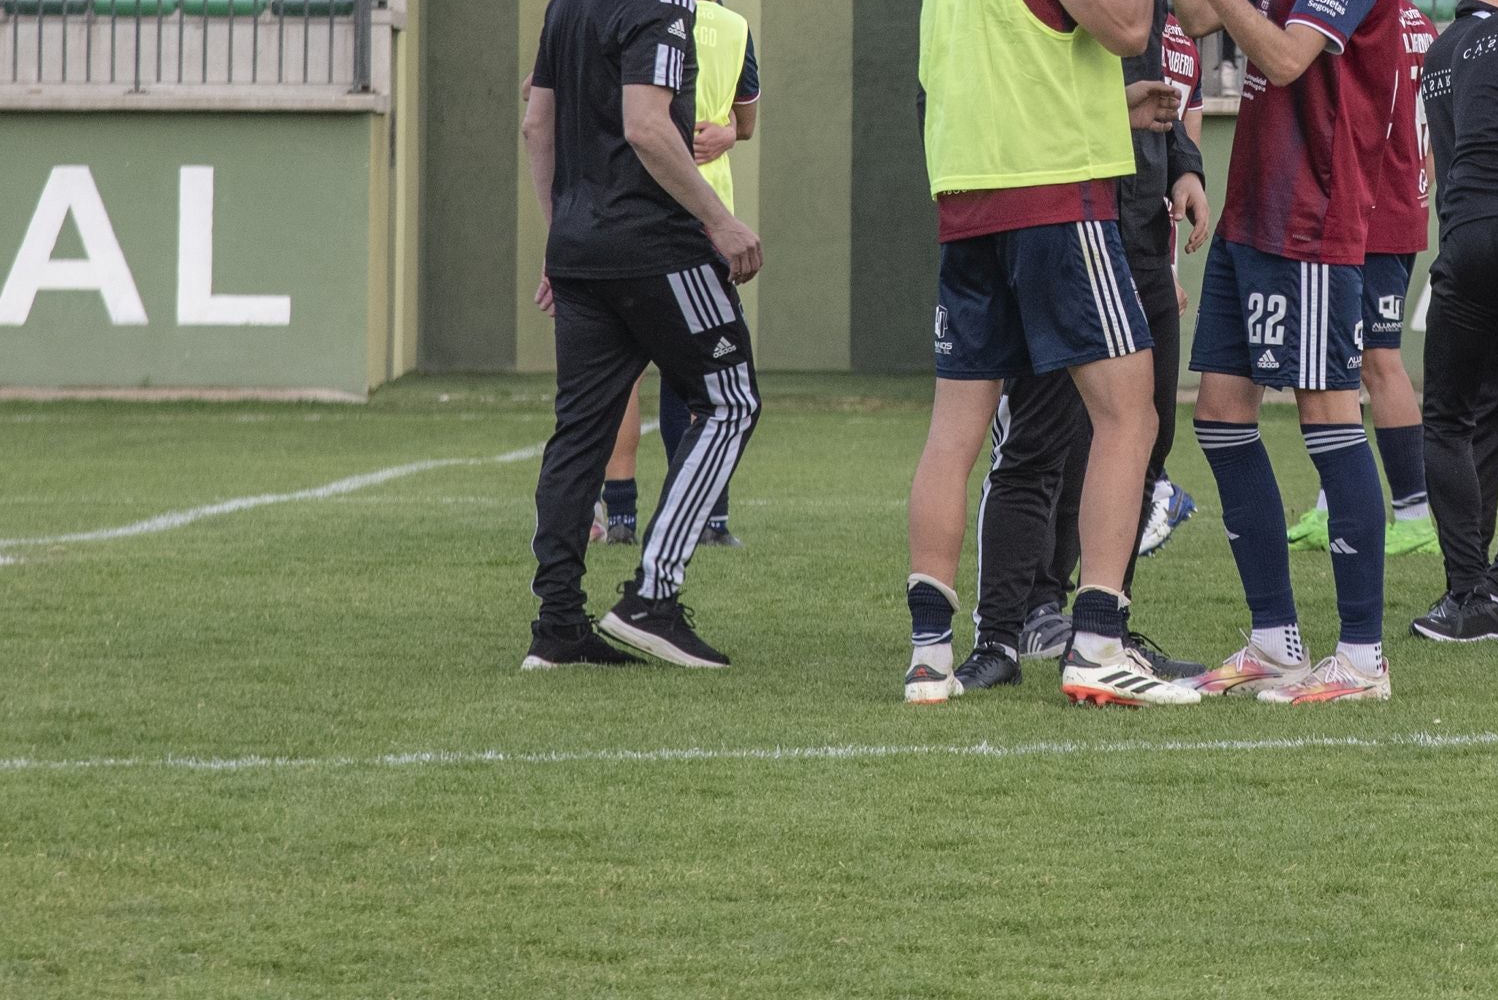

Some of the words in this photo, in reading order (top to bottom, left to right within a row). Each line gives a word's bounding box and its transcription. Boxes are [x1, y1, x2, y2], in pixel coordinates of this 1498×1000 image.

[1307, 0, 1337, 18] Segovia
[1247, 292, 1287, 346] 22
[712, 344, 737, 359] adidas
[1257, 361, 1280, 369] adidas
